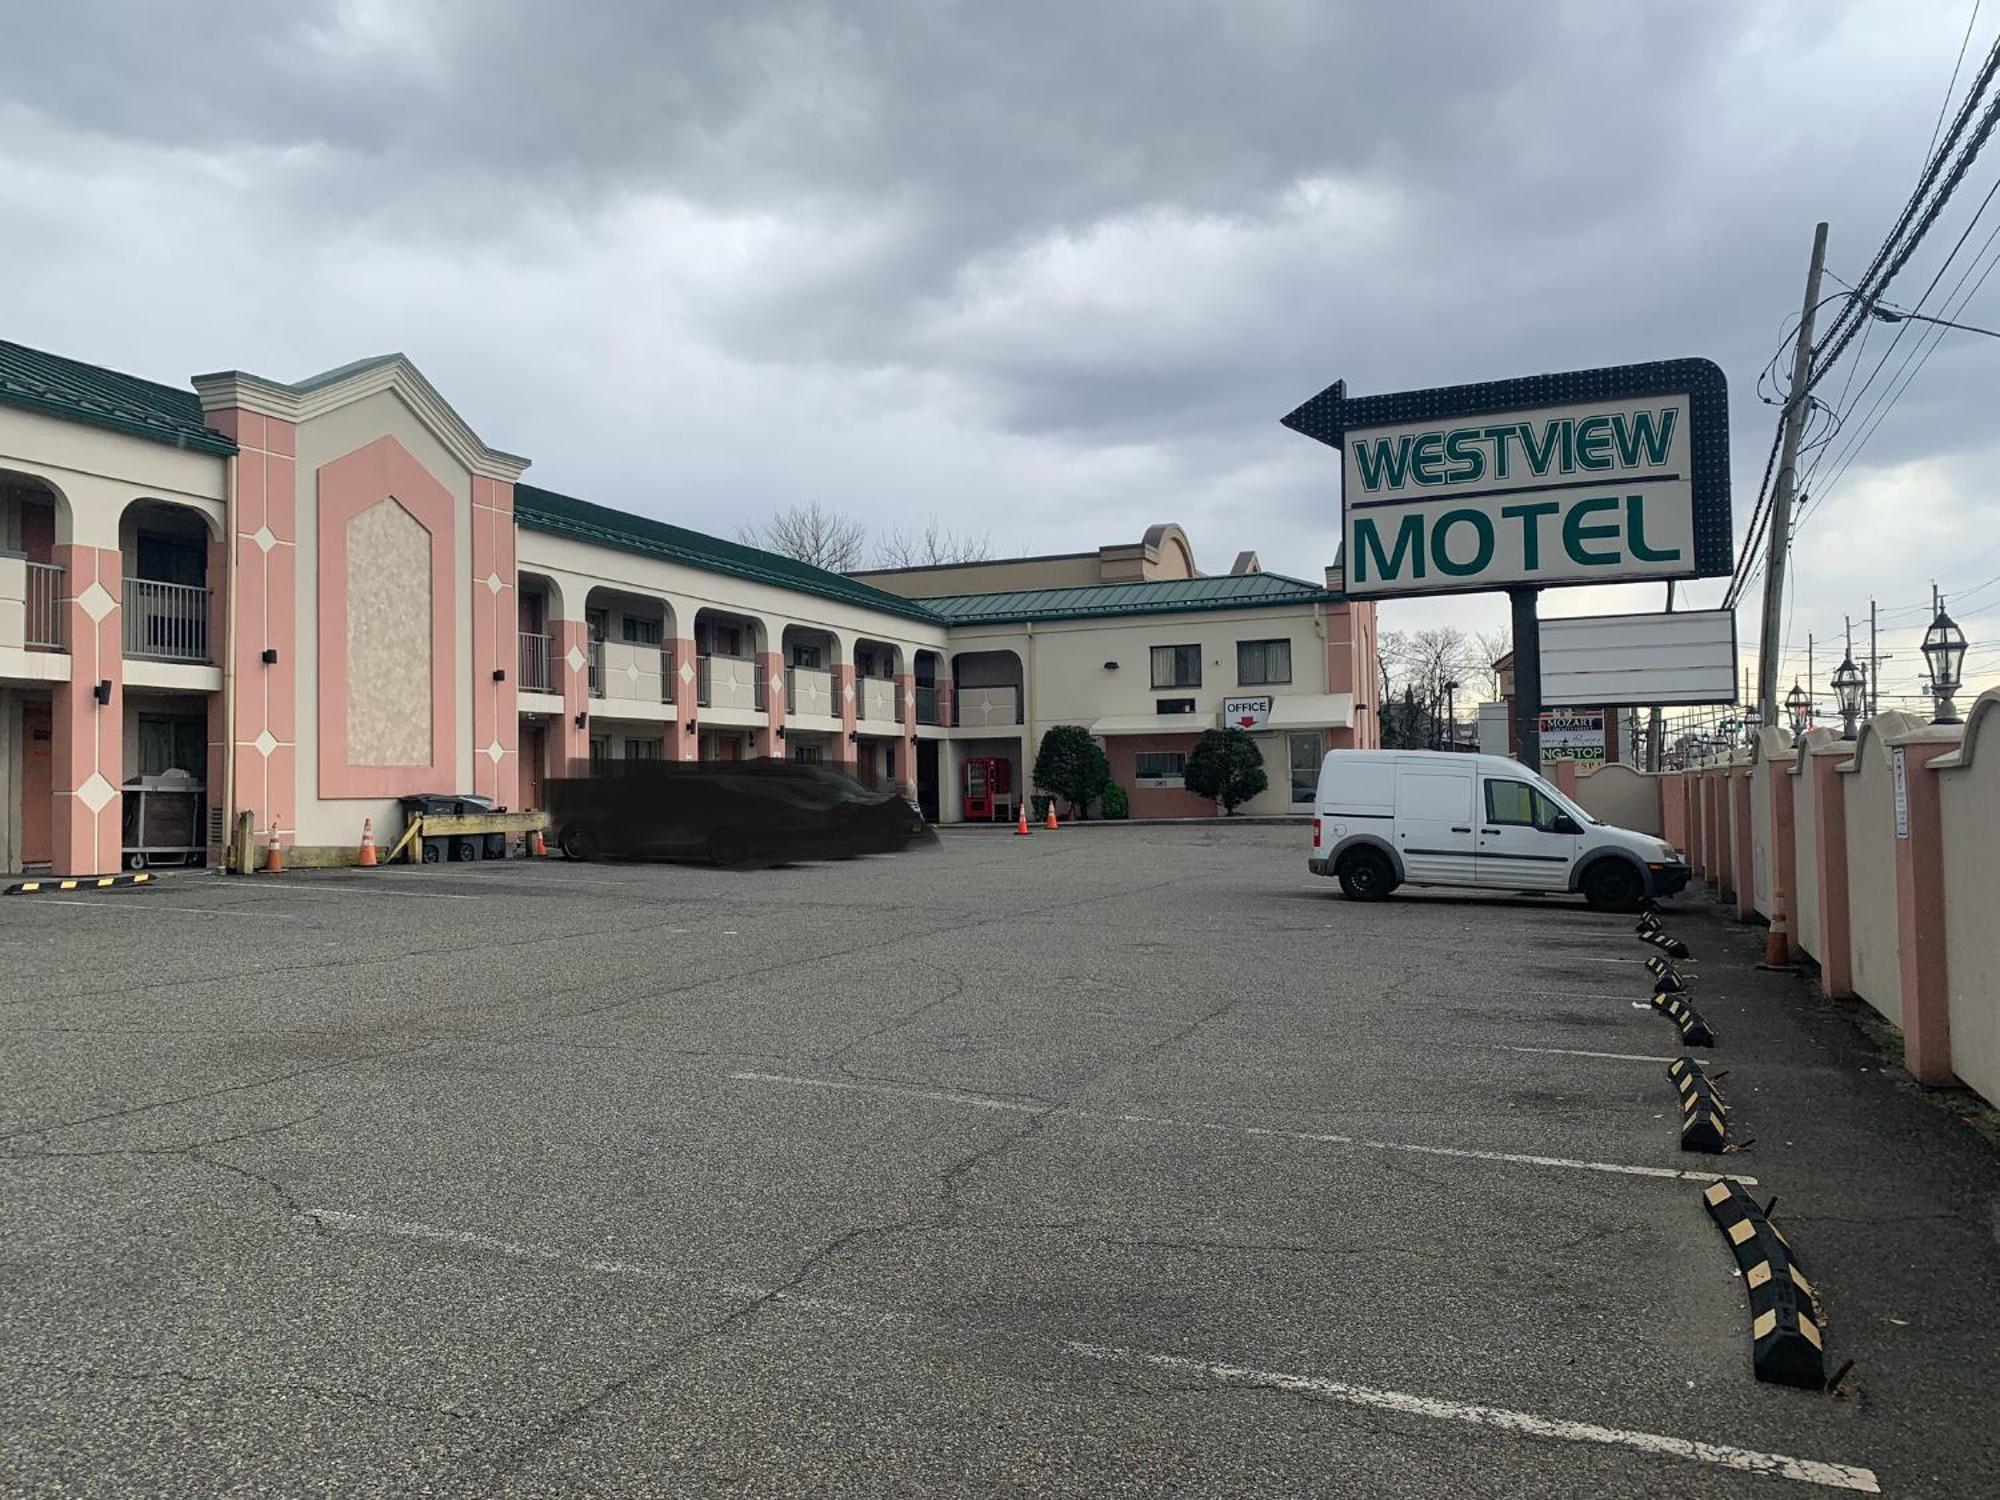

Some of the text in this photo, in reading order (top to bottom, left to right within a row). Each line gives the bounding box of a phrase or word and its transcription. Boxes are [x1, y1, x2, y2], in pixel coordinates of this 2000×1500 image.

[1352, 408, 1679, 492] WESTVIEW
[1353, 495, 1681, 583] MOTEL
[1227, 701, 1267, 713] OFFICE
[1547, 719, 1593, 728] MOZART
